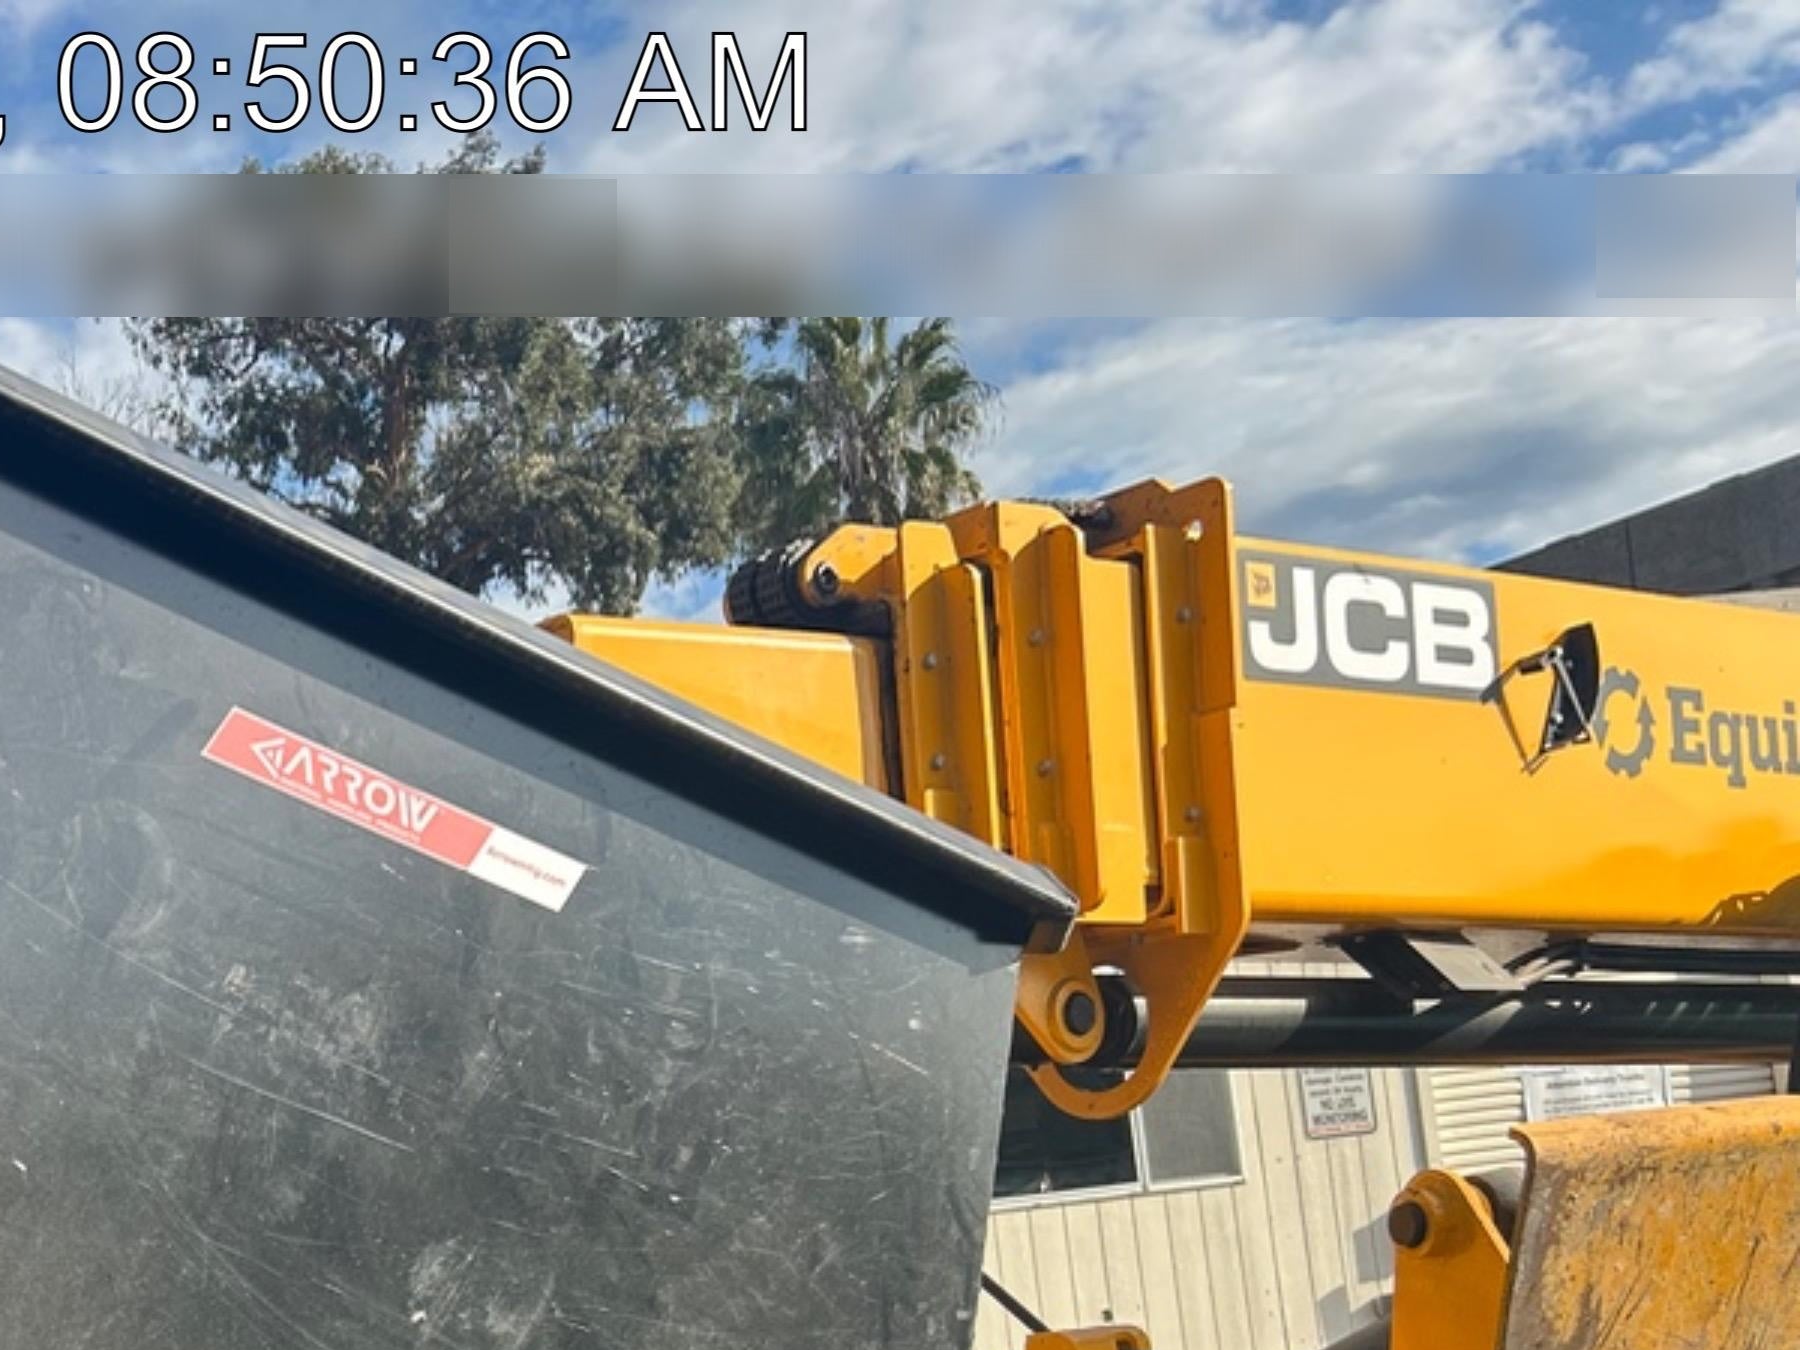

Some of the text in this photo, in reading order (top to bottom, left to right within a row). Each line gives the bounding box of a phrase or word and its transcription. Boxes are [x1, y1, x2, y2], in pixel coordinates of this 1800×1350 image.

[1247, 566, 1496, 690] JCB
[282, 745, 441, 833] ARROW
[1665, 686, 1800, 789] Equi
